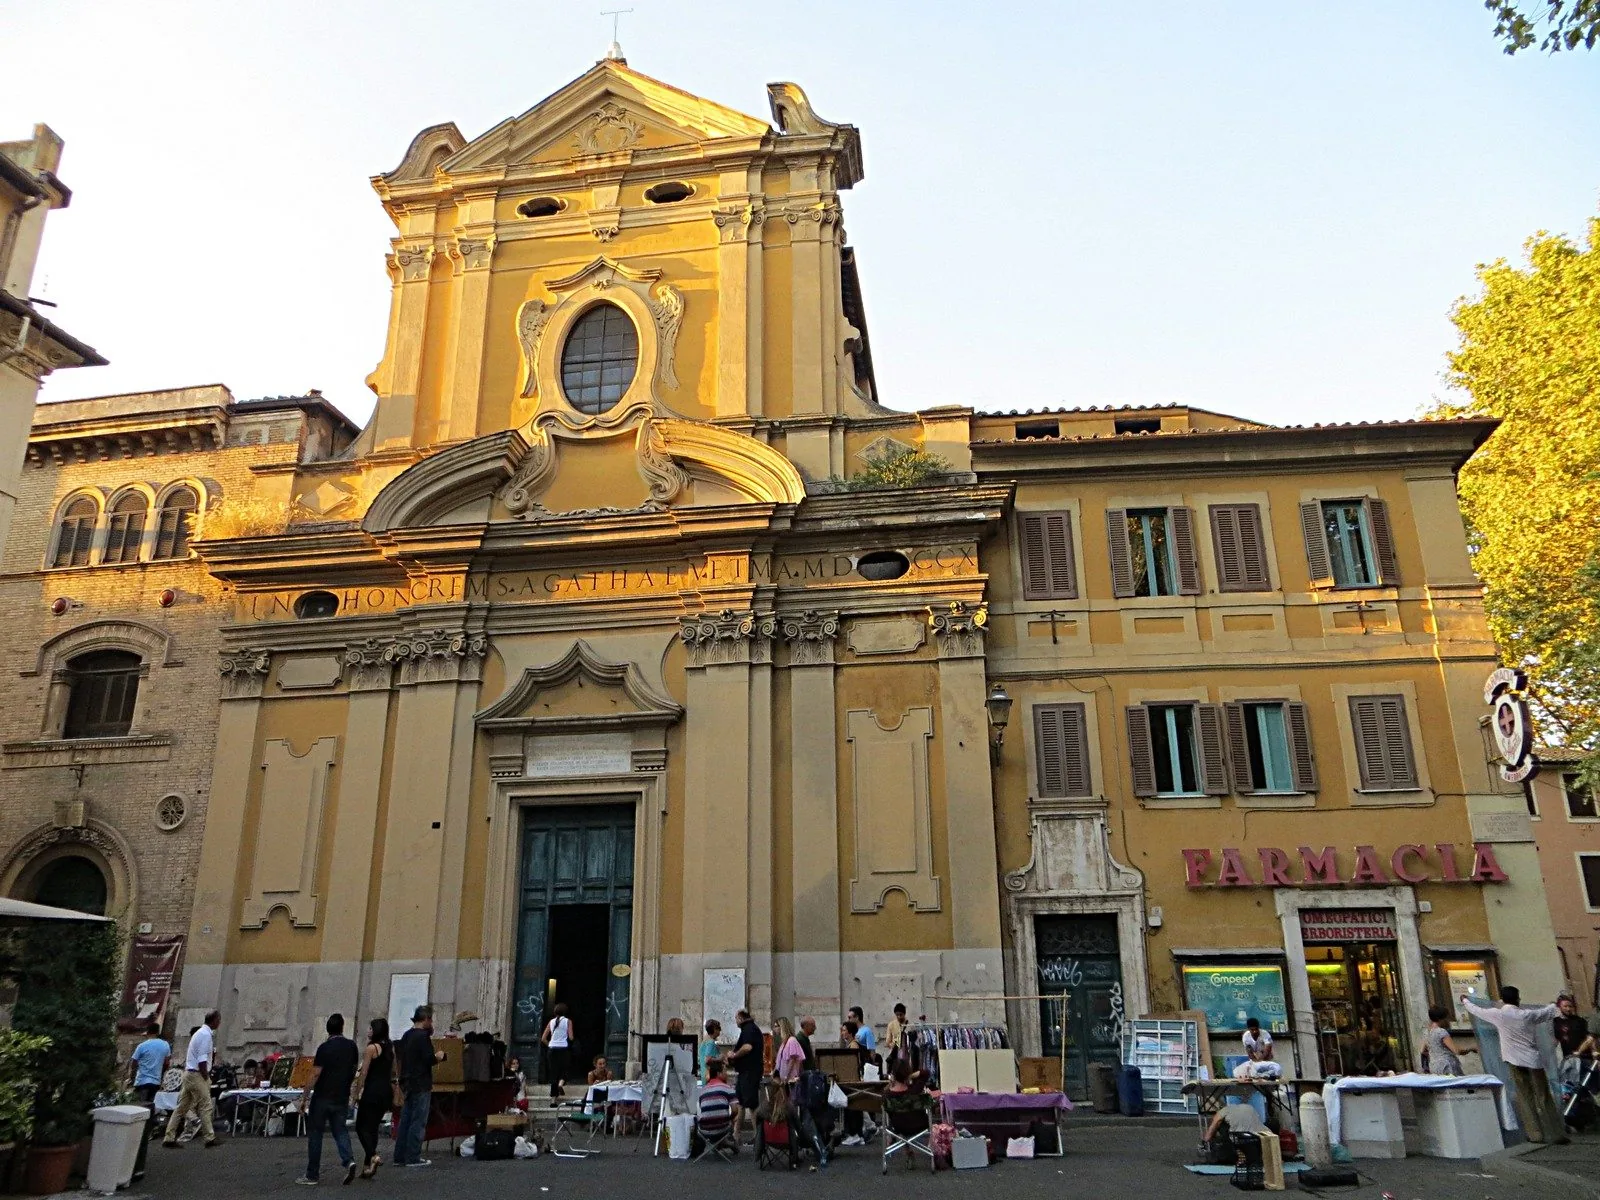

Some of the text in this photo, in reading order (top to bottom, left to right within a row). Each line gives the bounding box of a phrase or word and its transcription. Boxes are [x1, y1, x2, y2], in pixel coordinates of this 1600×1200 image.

[1181, 842, 1510, 890] FARMACIA
[1303, 911, 1388, 924] OMEOPATICI
[1302, 926, 1395, 940] ERBORISTERIA
